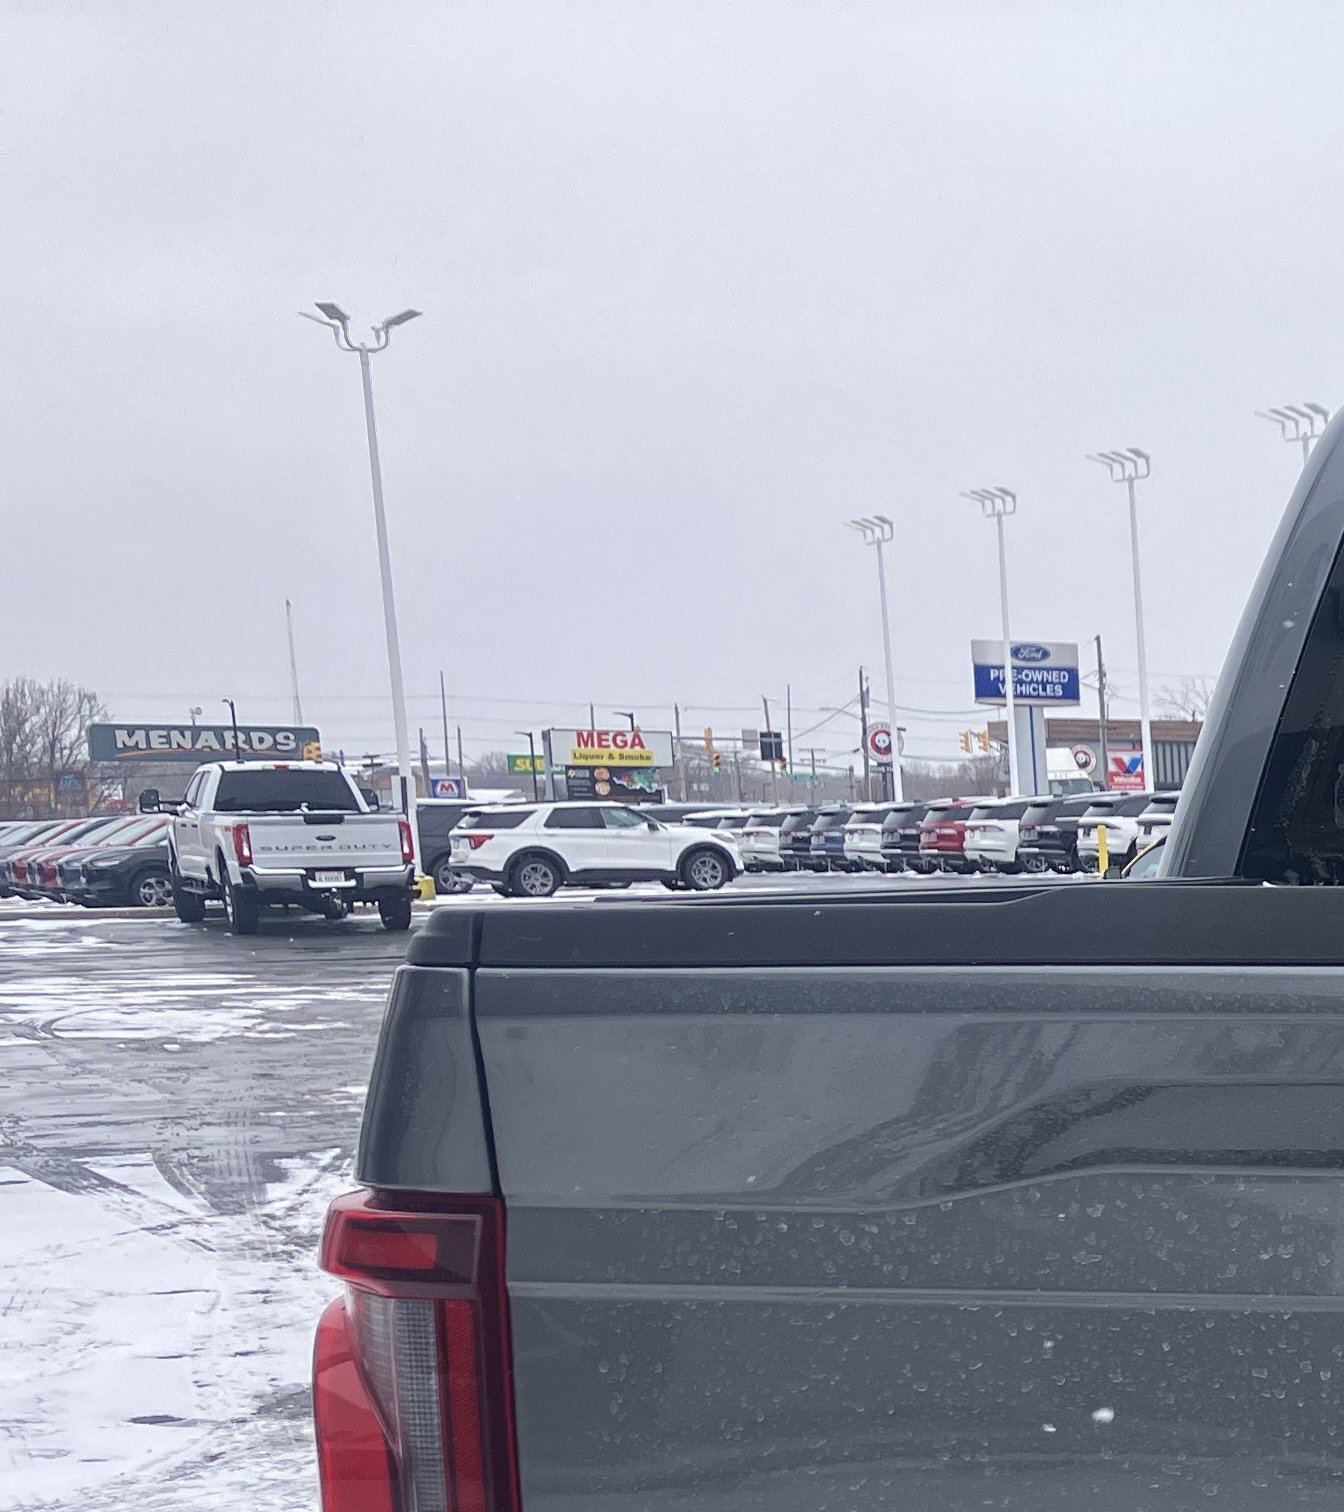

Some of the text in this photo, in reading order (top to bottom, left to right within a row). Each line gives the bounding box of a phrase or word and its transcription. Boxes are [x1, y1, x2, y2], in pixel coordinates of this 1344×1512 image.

[1017, 646, 1044, 660] Ford
[115, 728, 297, 752] MENARDS
[576, 730, 646, 749] MEGA
